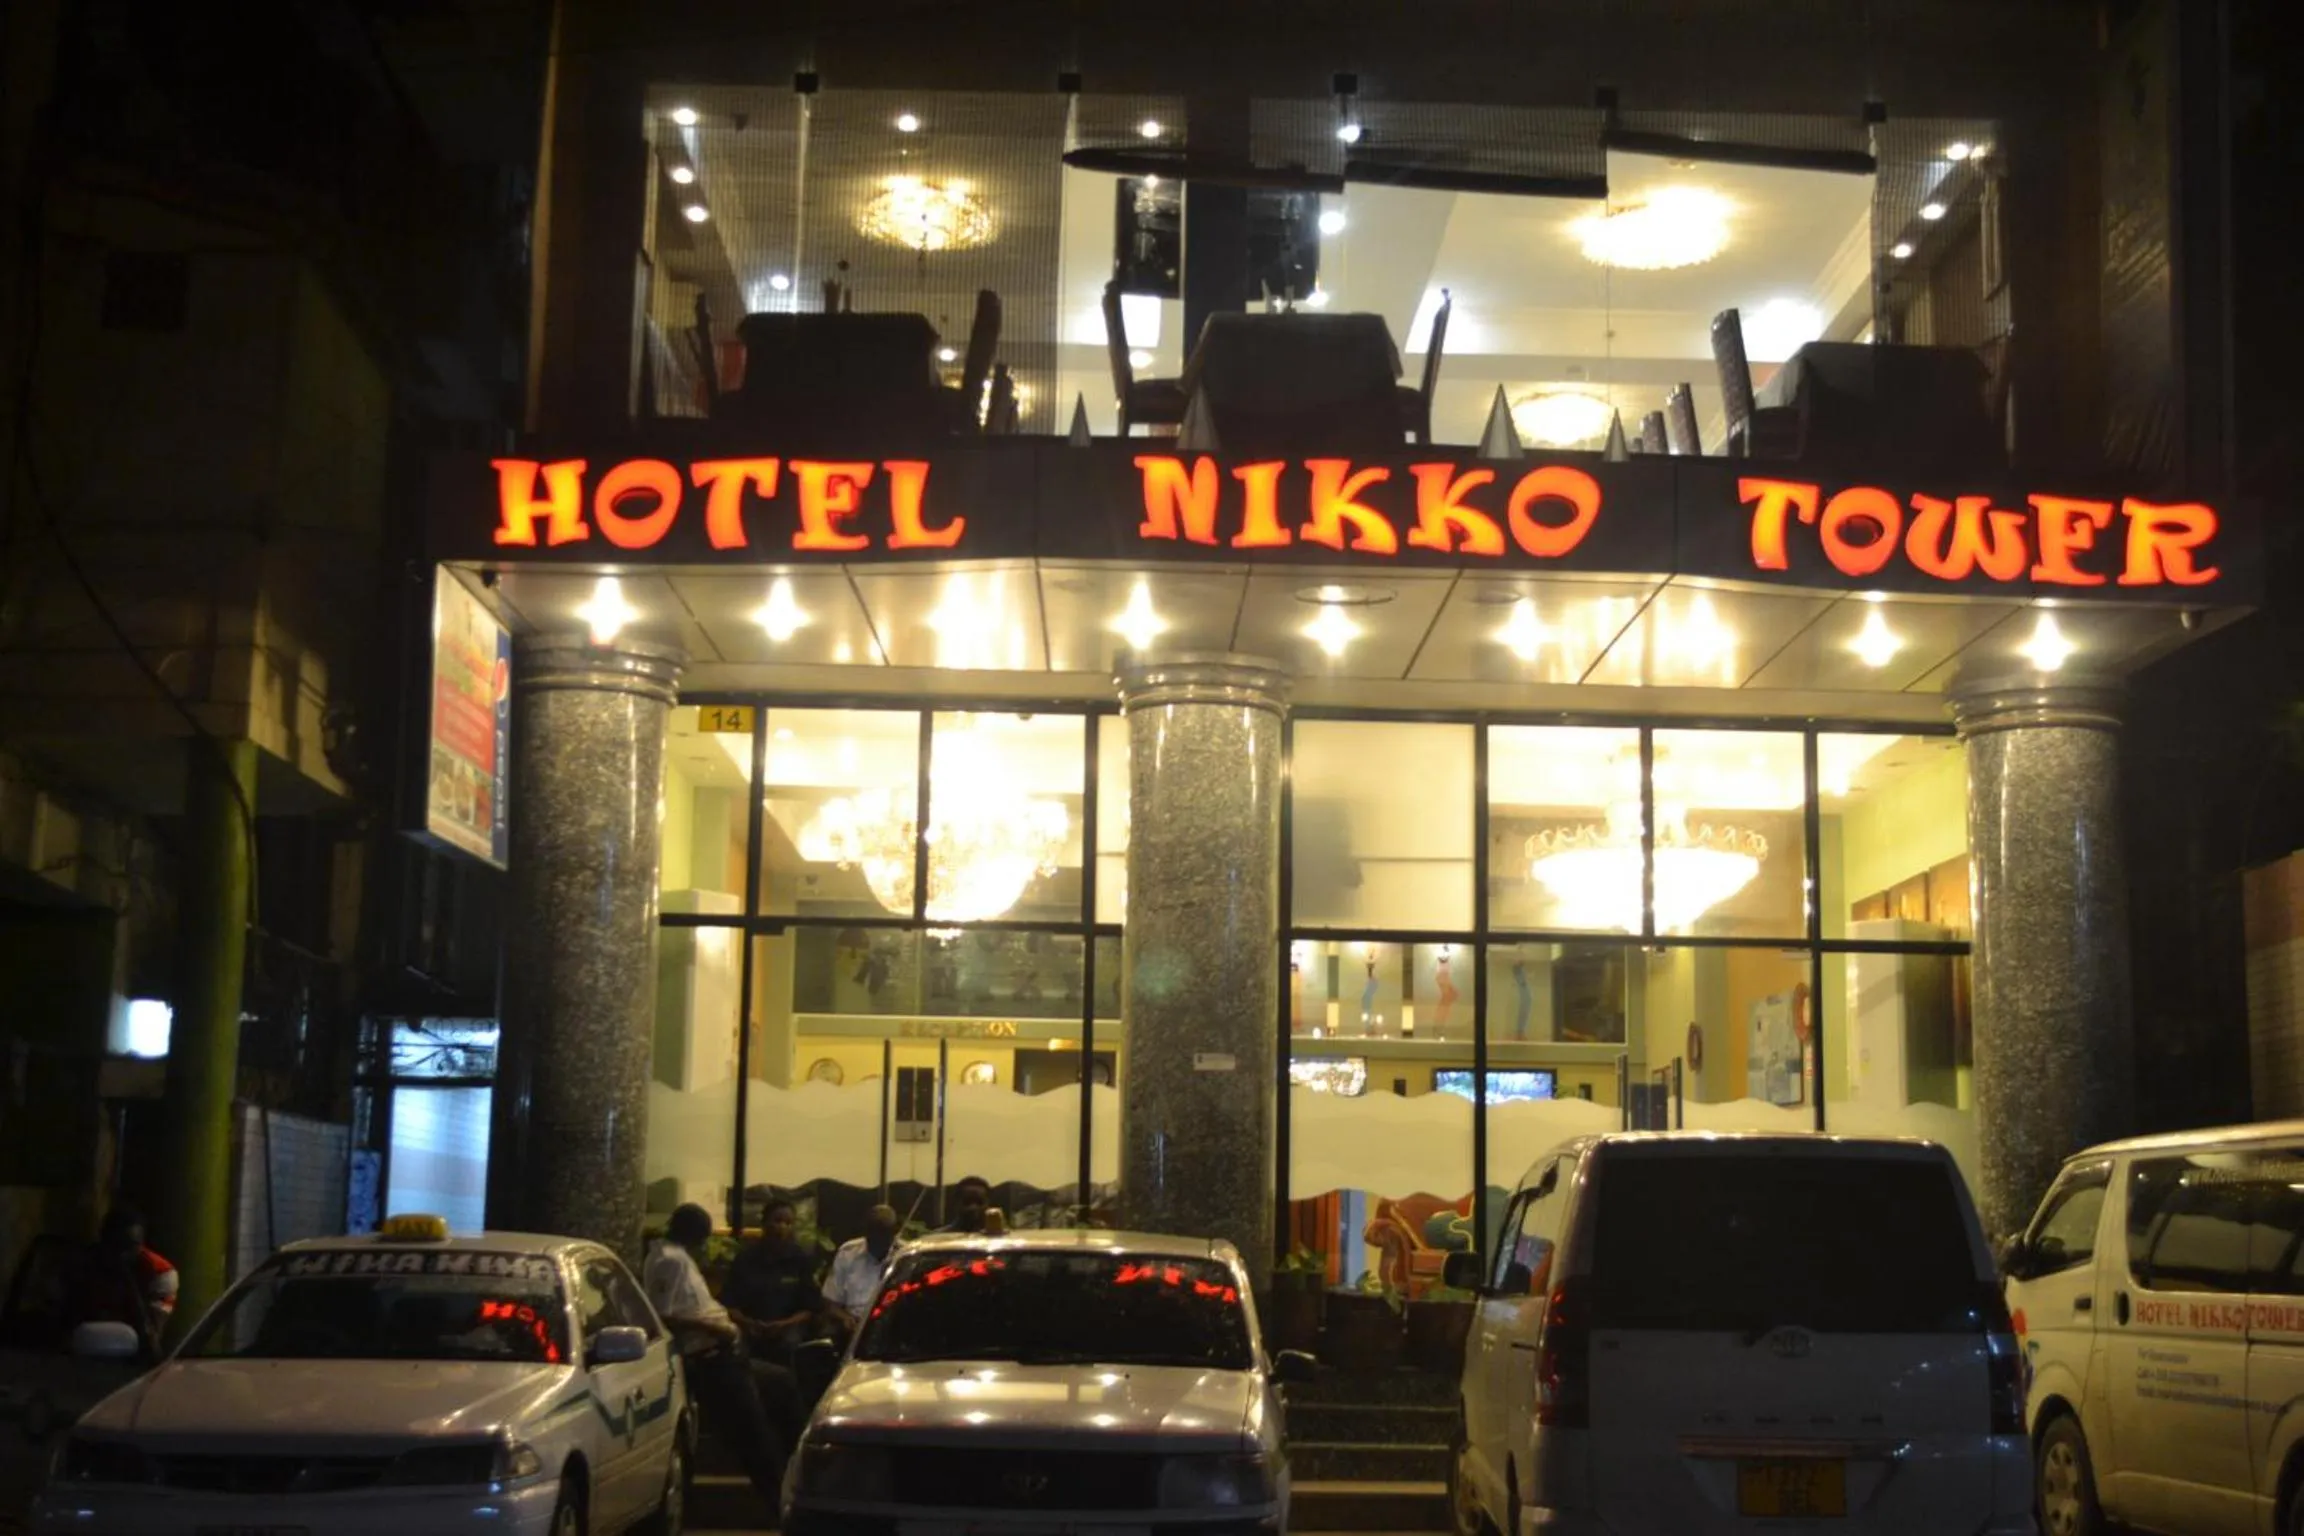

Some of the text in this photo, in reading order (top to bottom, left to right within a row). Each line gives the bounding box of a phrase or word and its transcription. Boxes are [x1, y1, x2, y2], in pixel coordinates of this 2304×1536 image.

[491, 455, 2218, 586] HOTEL NIKKO TOWER
[711, 708, 744, 730] 14
[2136, 1301, 2185, 1327] HOTEL
[2189, 1303, 2243, 1332] NIKKO
